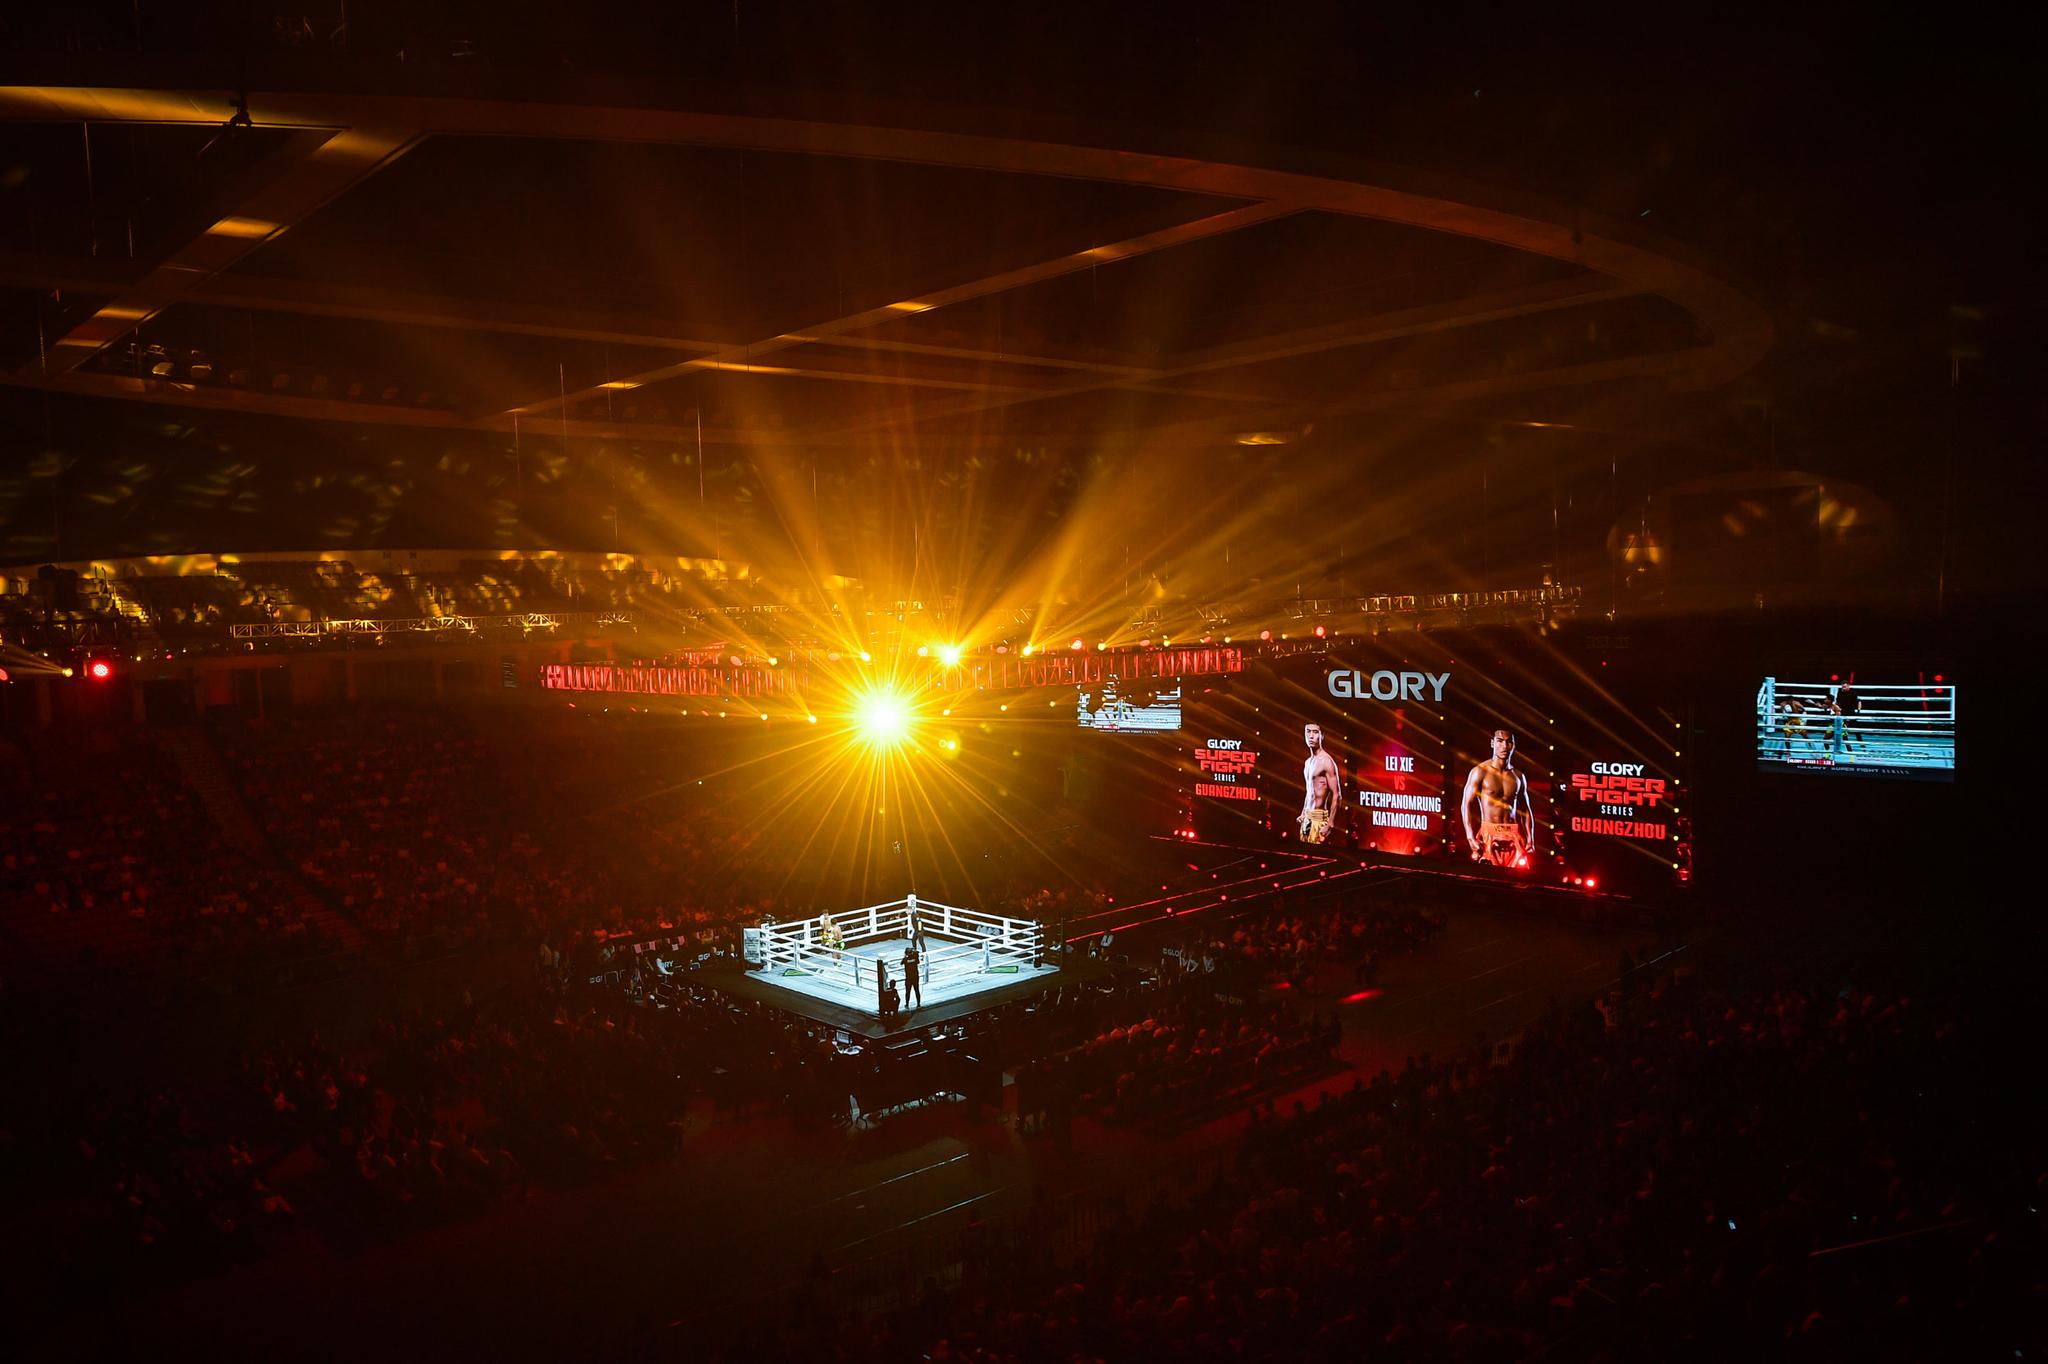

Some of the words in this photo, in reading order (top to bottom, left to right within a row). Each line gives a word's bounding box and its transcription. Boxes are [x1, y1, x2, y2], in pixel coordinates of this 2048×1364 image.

[1328, 670, 1450, 702] GLORY
[1207, 739, 1242, 749] GLORY
[1195, 749, 1256, 763] SUPER
[1385, 756, 1399, 771] LEI
[1400, 756, 1414, 773] XIE
[1200, 760, 1254, 774] FIGHT
[1591, 762, 1644, 776] GLORY
[1214, 773, 1235, 782] SERIES
[1393, 775, 1406, 791] VS
[1571, 773, 1665, 793] SUPER
[1195, 783, 1257, 800] GUANGZHOU
[1580, 788, 1663, 807] FIGHT
[1360, 791, 1441, 813] PETCHPANOMRUNG
[1601, 805, 1633, 816] SERIES
[1372, 810, 1428, 831] KIATMOOKAO
[1571, 816, 1666, 840] GUANGZHOU
